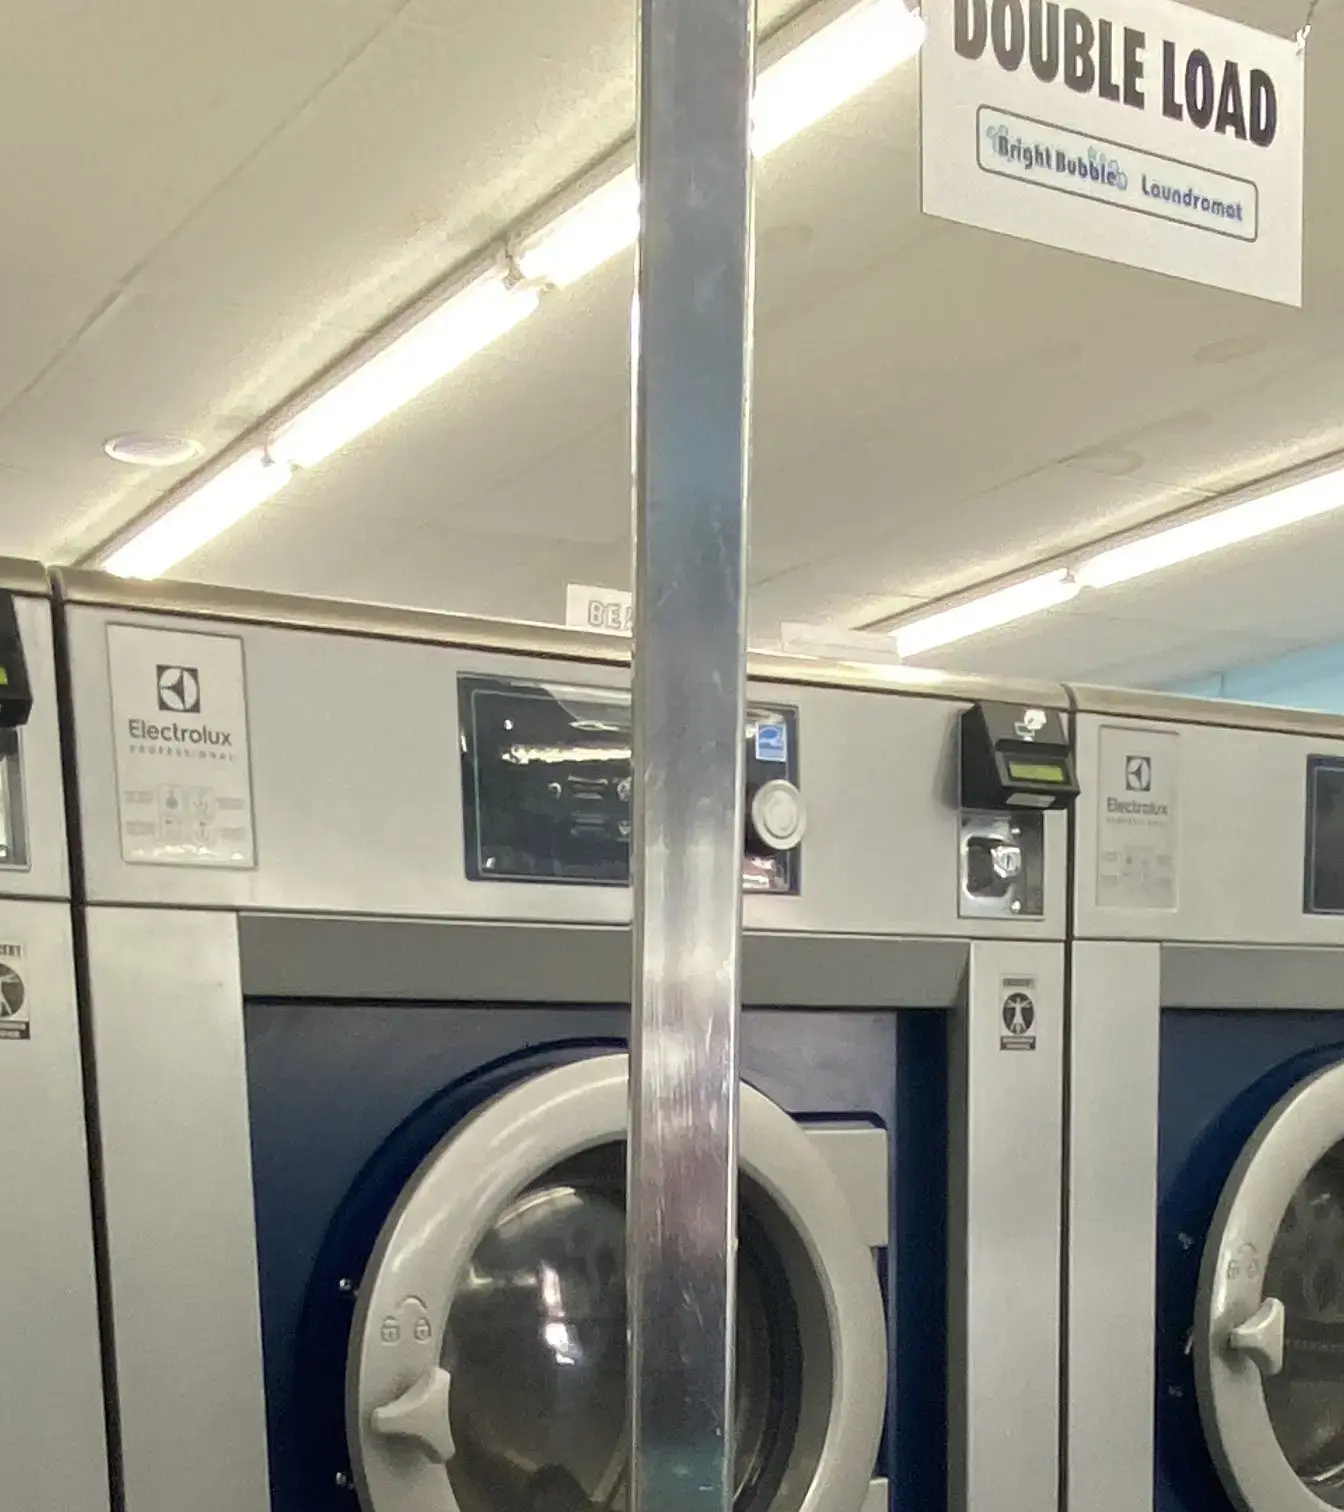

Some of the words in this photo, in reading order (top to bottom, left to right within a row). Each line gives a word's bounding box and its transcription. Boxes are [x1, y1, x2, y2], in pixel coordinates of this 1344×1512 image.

[954, 0, 1145, 110] DOUBLE
[1162, 39, 1278, 148] LOAD
[998, 135, 1053, 170] Bright
[1142, 174, 1244, 222] Laundromat
[128, 718, 233, 747] Electrolux
